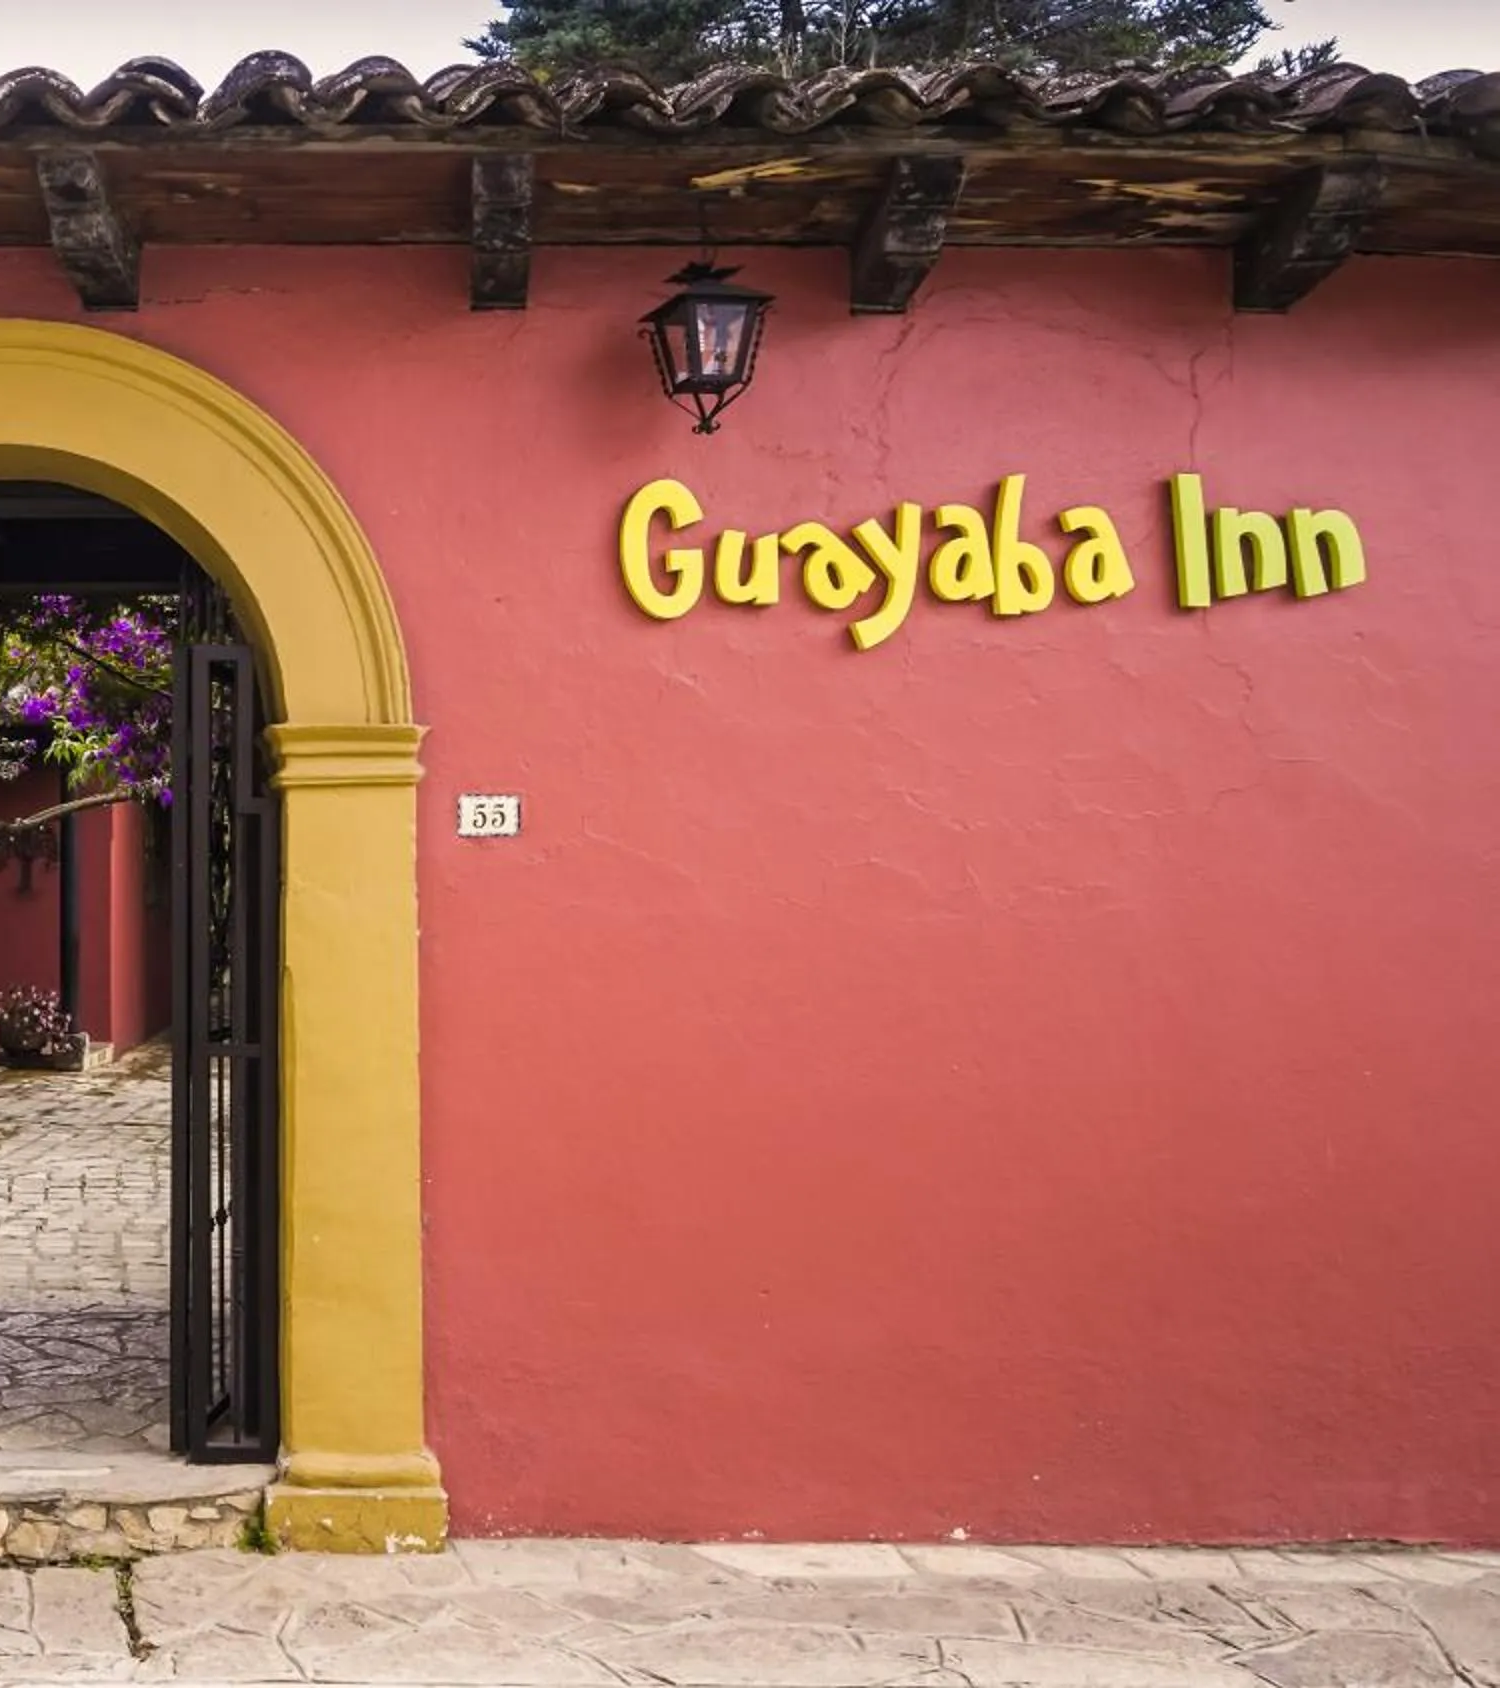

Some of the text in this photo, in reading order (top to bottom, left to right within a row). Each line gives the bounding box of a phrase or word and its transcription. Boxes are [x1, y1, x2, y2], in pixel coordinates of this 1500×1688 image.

[619, 472, 1366, 651] Guayaba Inn
[472, 803, 506, 829] 55
